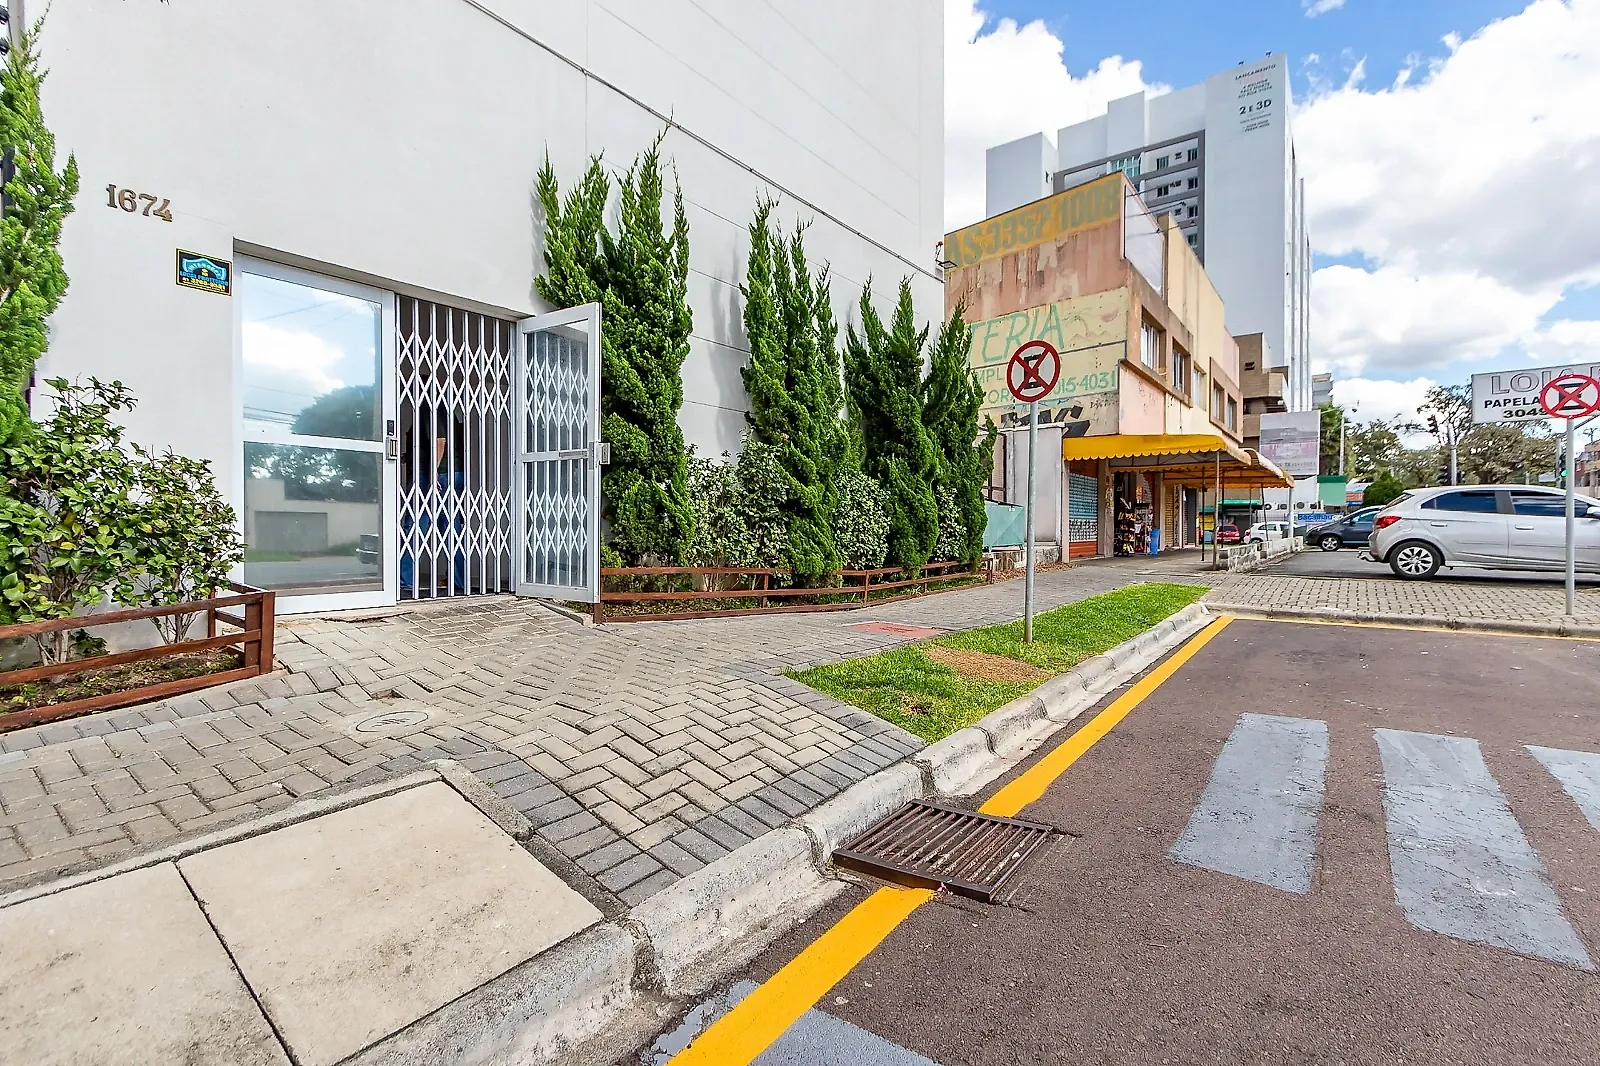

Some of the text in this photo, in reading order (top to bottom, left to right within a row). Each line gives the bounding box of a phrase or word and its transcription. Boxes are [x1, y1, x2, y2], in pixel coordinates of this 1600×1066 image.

[1239, 106, 1246, 115] 2
[1256, 98, 1272, 110] 3D
[106, 184, 173, 222] 1674
[1058, 182, 1121, 229] 1008
